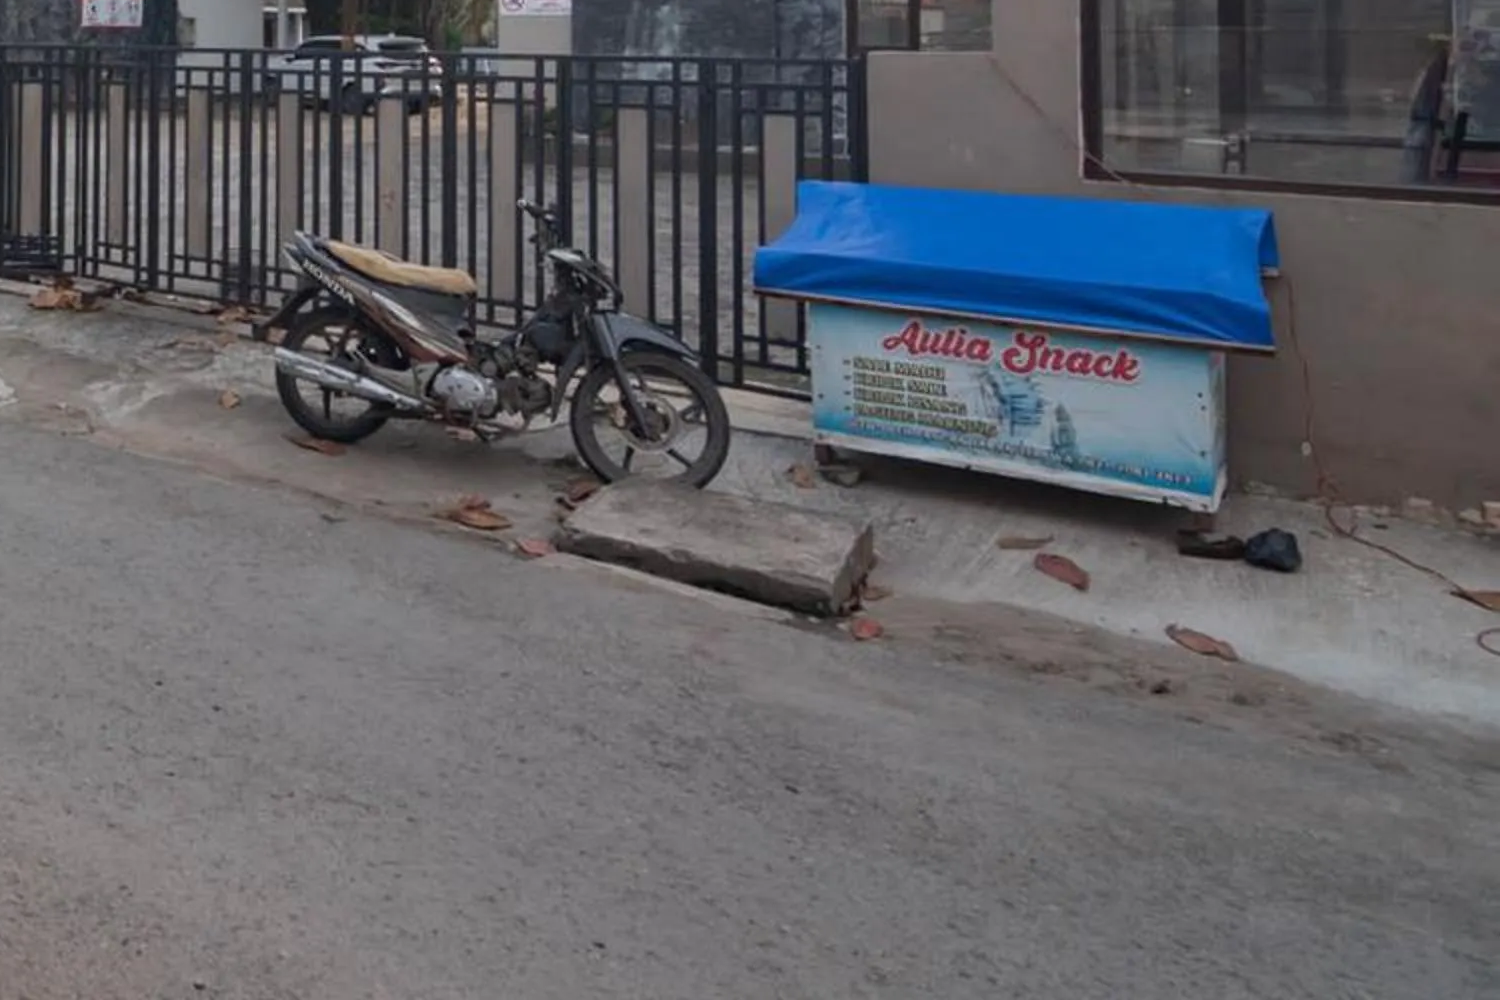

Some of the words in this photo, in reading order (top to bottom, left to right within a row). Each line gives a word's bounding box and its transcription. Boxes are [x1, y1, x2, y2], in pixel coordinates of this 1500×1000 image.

[303, 259, 355, 306] HONDA
[882, 320, 991, 362] Aulia
[1002, 331, 1140, 382] Snack
